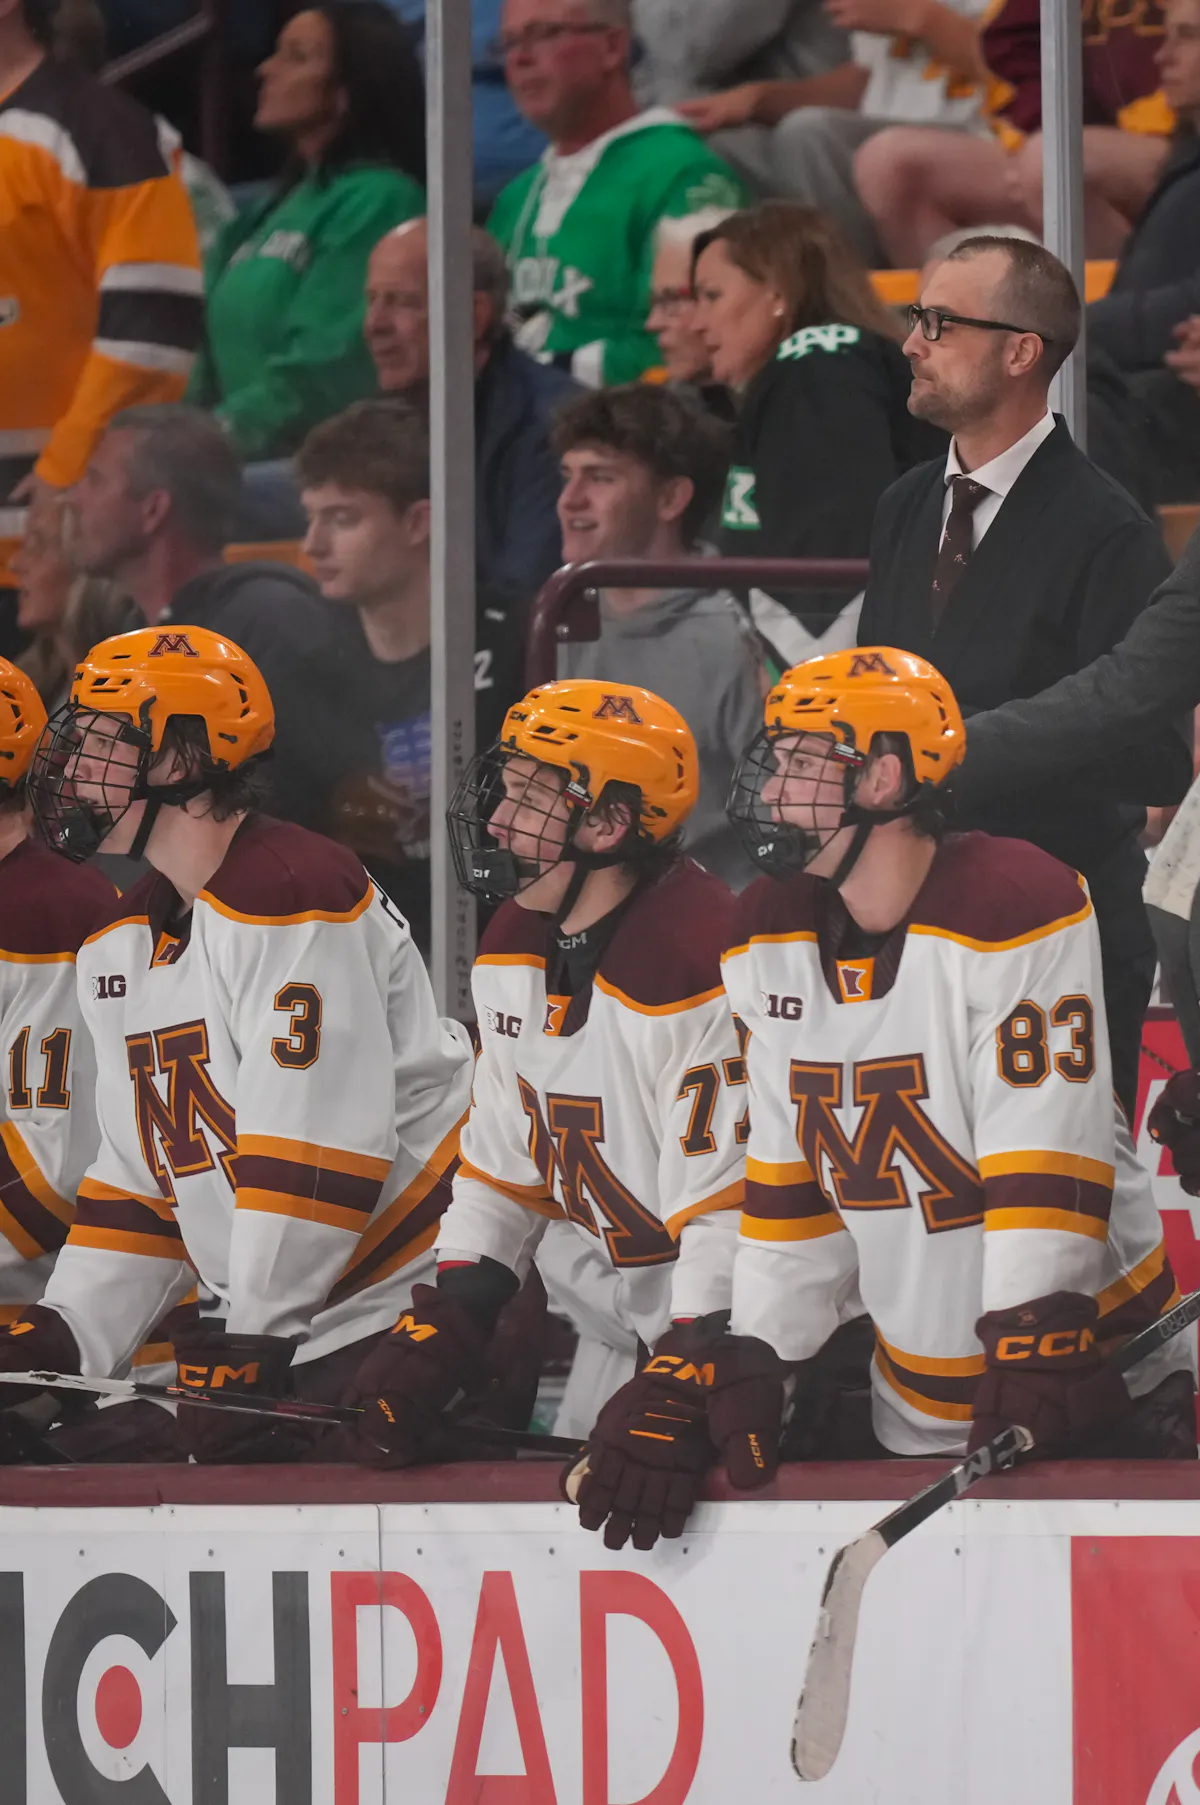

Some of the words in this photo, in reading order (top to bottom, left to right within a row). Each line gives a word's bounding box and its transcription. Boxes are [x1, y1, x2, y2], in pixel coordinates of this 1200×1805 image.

[148, 633, 200, 658] M
[846, 652, 897, 678] M
[592, 694, 643, 725] M
[8, 1025, 72, 1111] 11
[270, 981, 323, 1071] 3
[995, 993, 1096, 1088] 83
[789, 1052, 985, 1235] M
[0, 1569, 706, 1805] CHPAD
